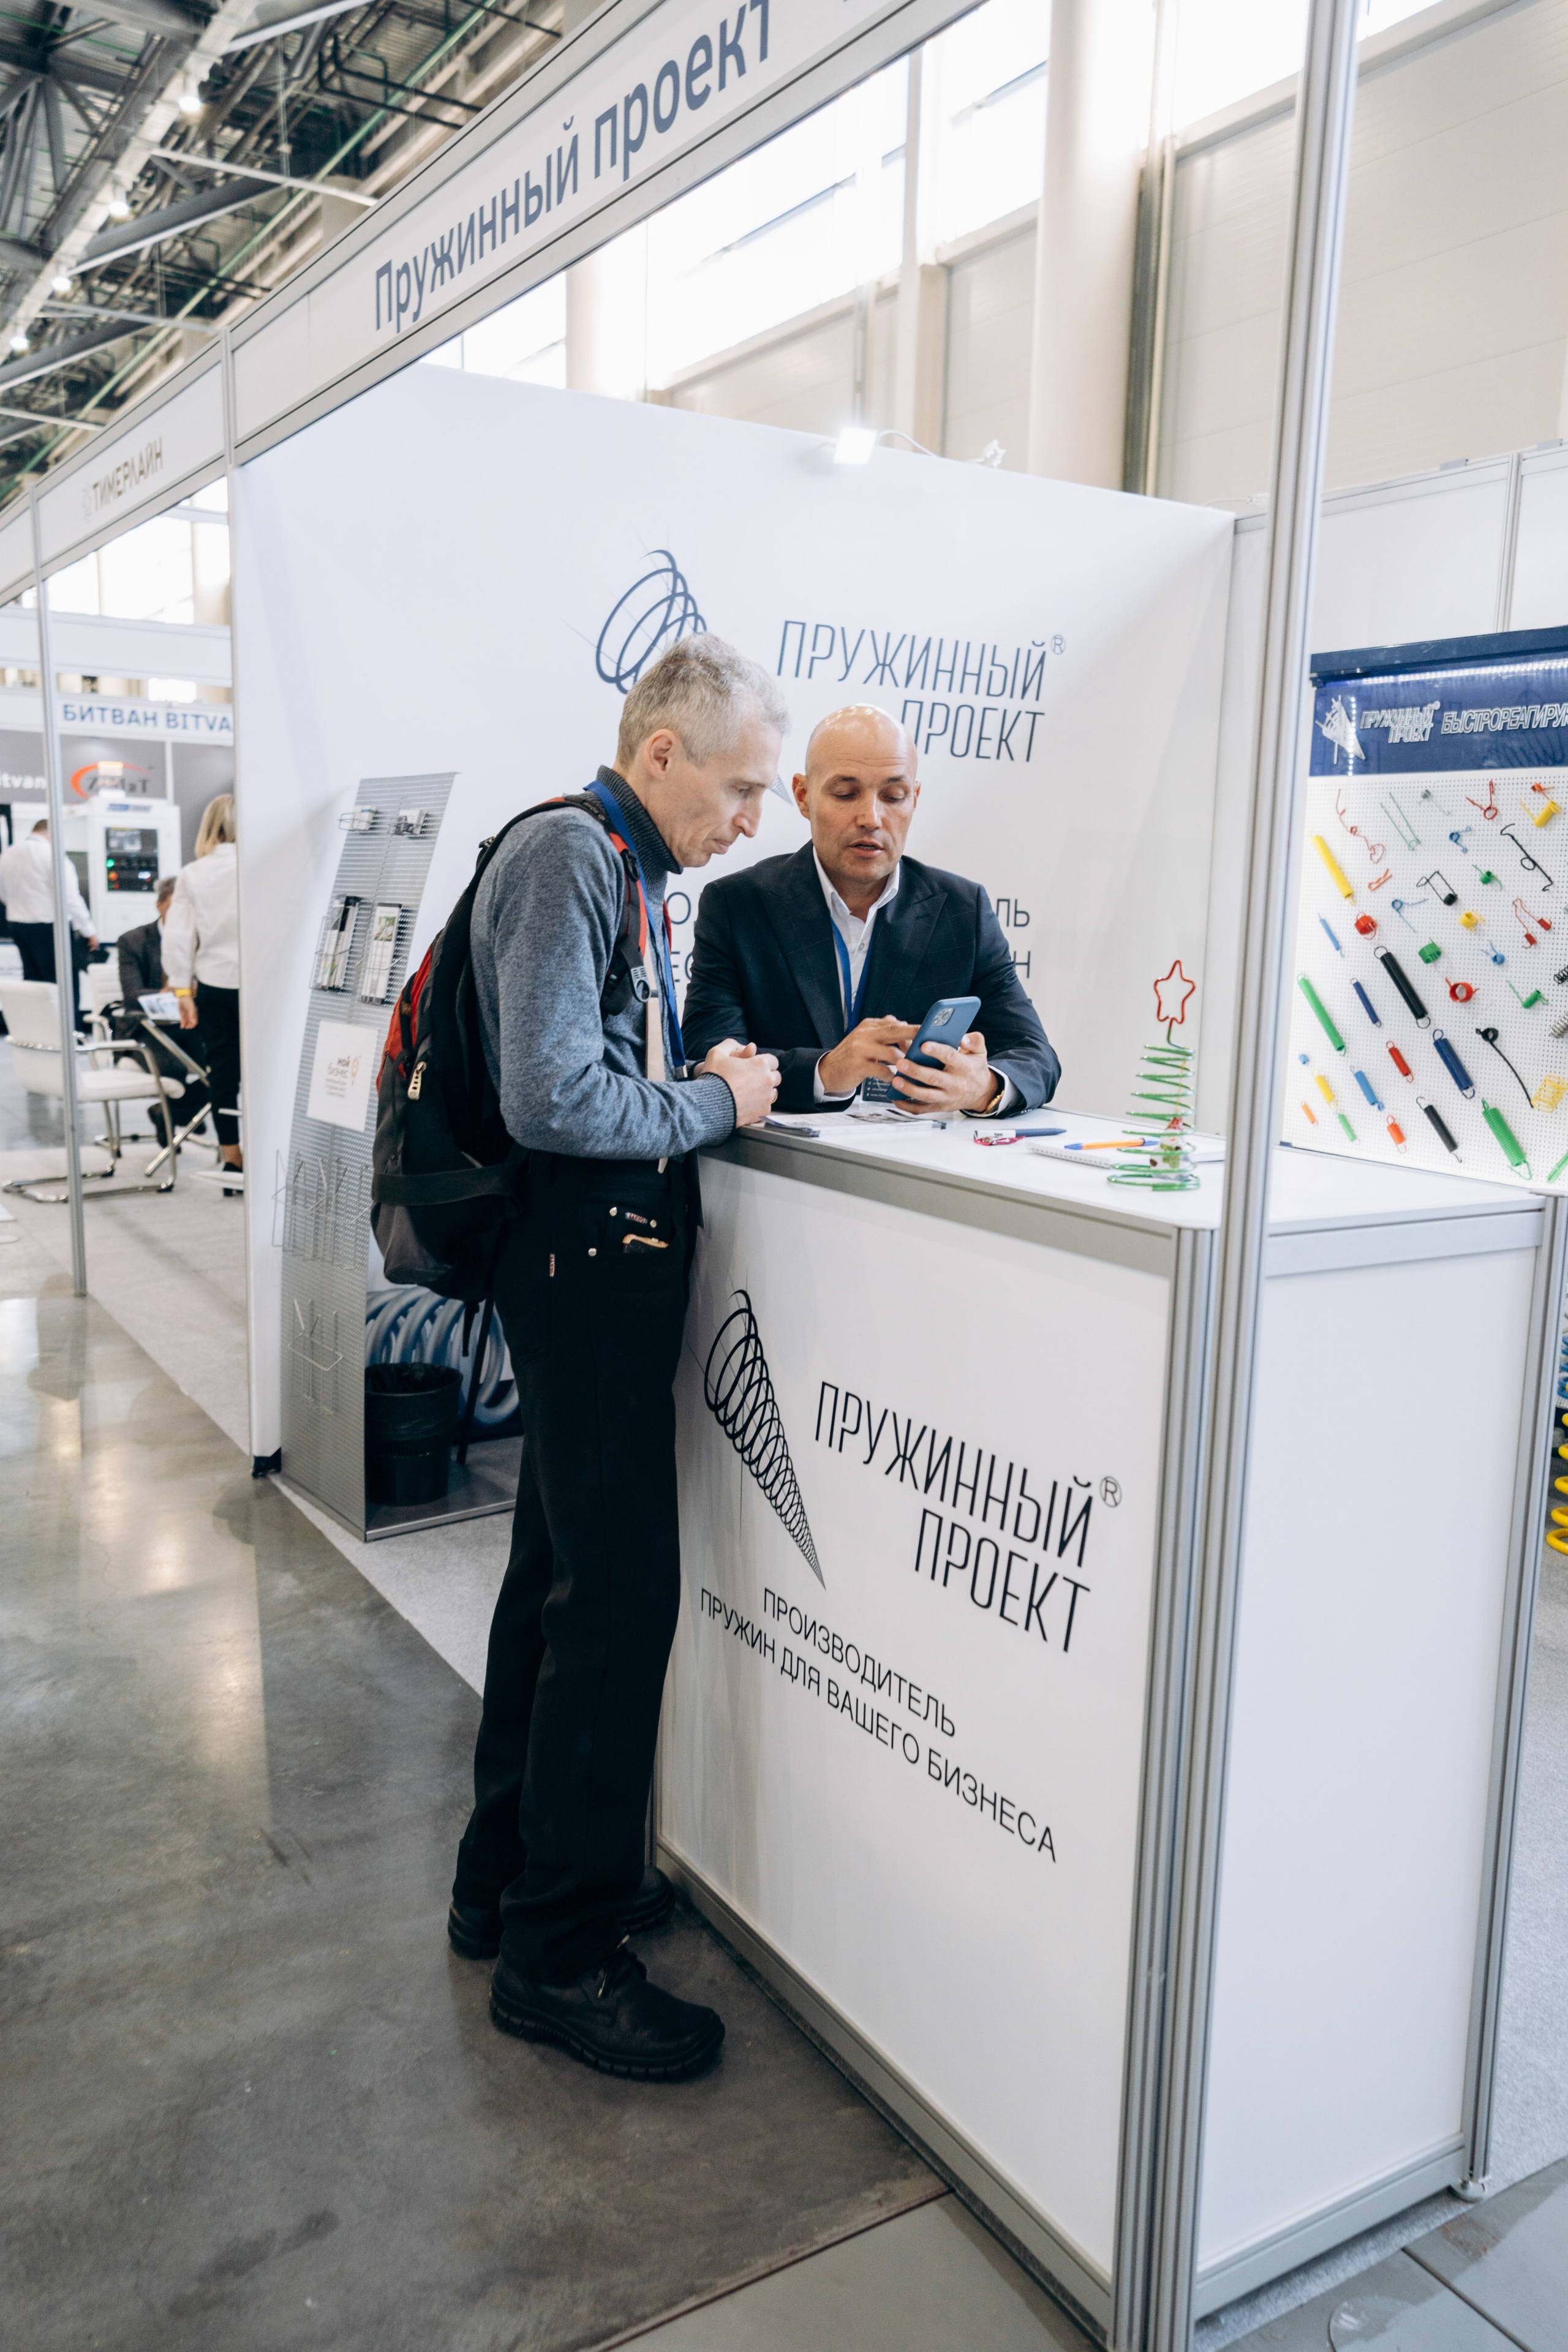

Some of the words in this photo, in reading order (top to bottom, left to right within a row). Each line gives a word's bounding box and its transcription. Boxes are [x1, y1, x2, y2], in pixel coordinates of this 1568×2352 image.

[375, 115, 579, 333] Пружинный
[594, 0, 769, 181] проект
[63, 704, 158, 728] БИТВАН
[901, 699, 1045, 762] ПРОЕКТ
[1388, 722, 1434, 744] ПРОЕКТ
[0, 772, 48, 790] tvan
[915, 1508, 1090, 1653] ПРОЕКТ
[763, 1587, 956, 1738] ПРОИЗВОДИТЕЛЬ
[701, 1587, 775, 1664] ПРУЖИН
[780, 1646, 820, 1697] ДЛЯ
[827, 1678, 920, 1765] ВАШЕГО
[928, 1747, 1057, 1864] БИЗНЕСА
